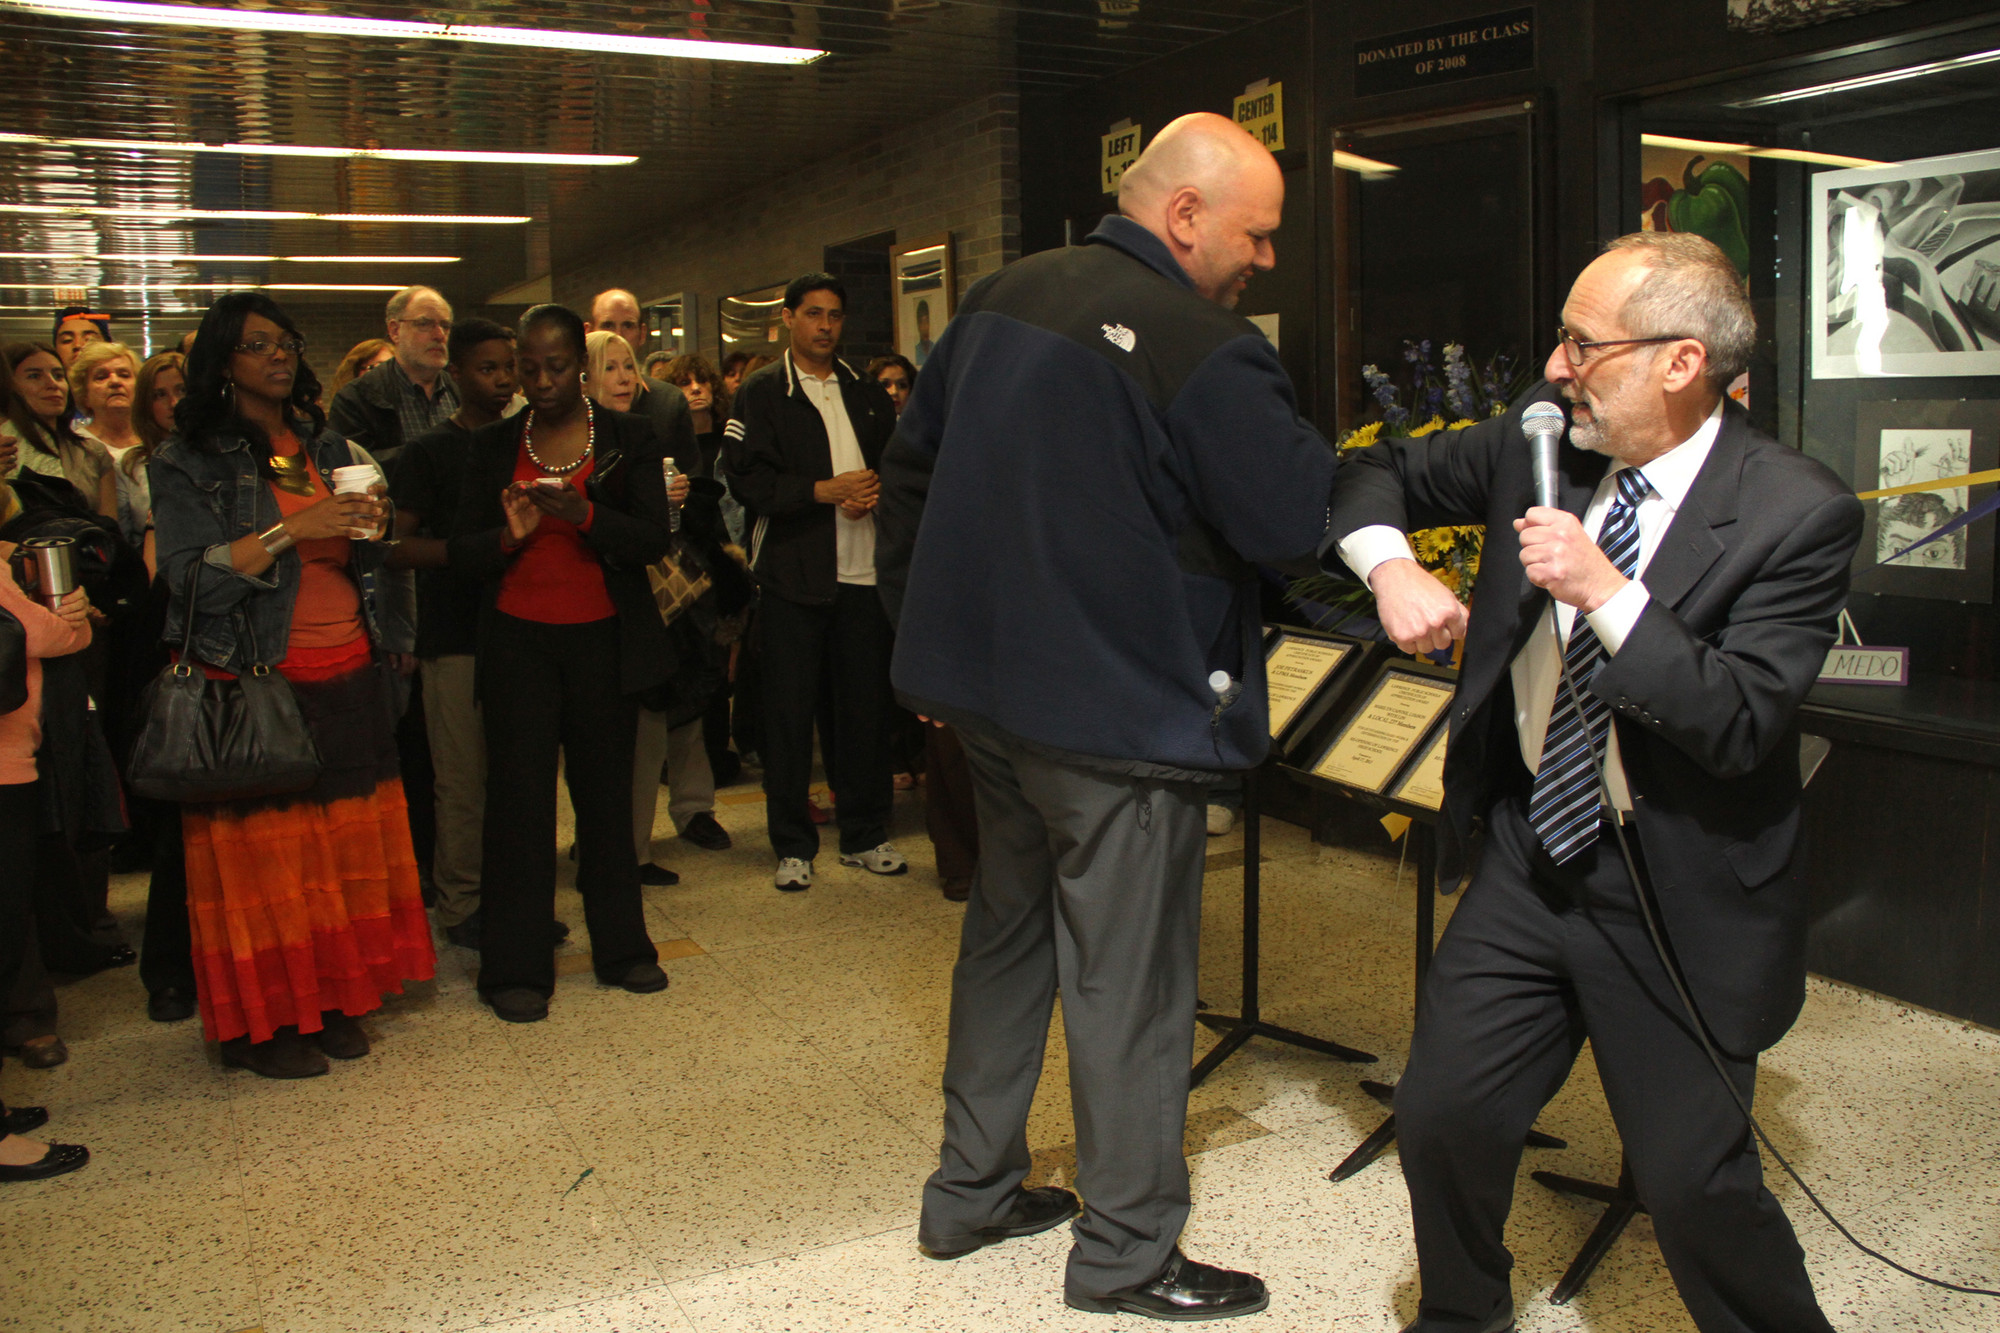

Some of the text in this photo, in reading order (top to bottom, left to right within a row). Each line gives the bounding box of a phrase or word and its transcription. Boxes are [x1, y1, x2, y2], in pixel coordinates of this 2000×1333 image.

[1358, 20, 1531, 65] DONATED BY THE CLASS
[1415, 54, 1467, 75] OF 2008
[1238, 92, 1274, 124] CENTER
[1107, 133, 1135, 158] LEFT
